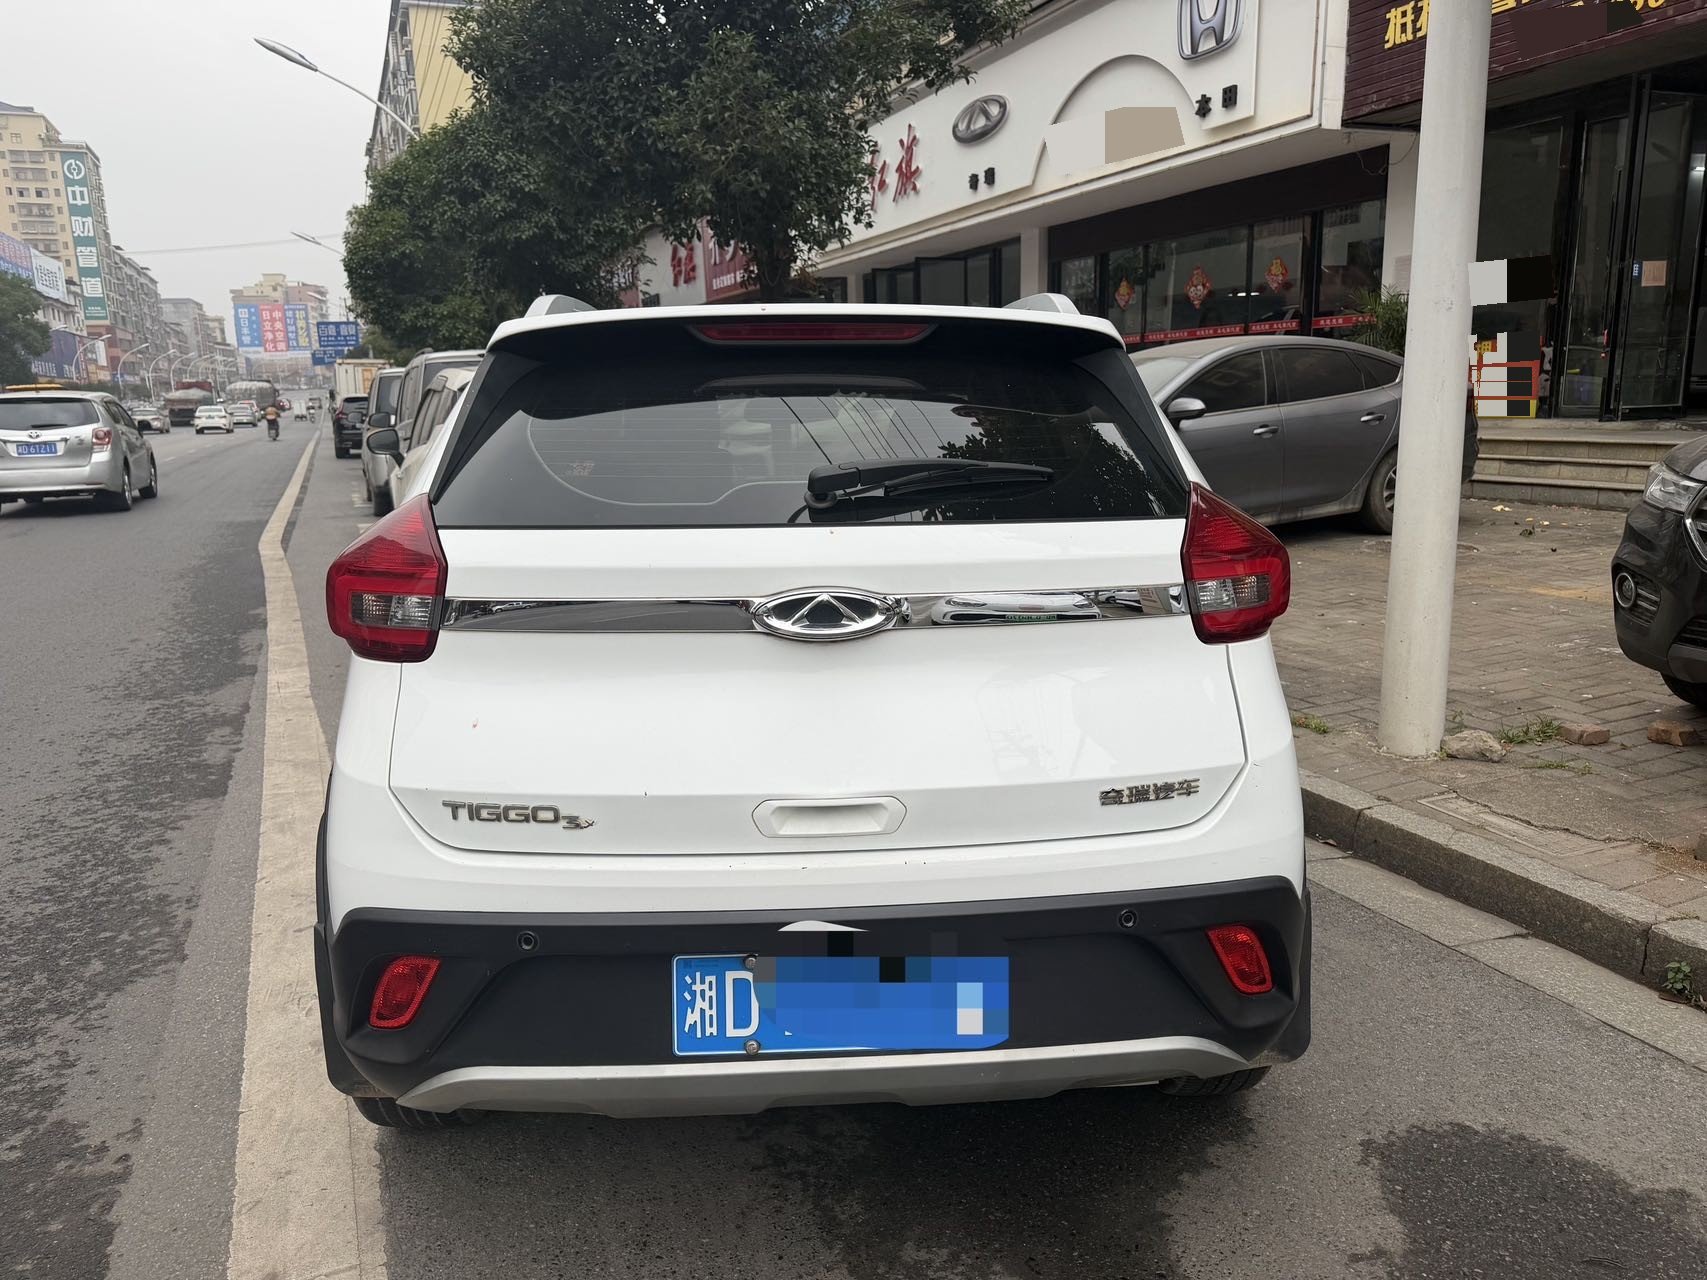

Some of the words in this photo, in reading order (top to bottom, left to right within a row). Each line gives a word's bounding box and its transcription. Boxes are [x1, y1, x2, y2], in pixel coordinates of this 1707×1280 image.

[1195, 85, 1238, 118] 本田
[66, 185, 104, 298] 中财管道
[1099, 779, 1201, 807] 奇瑞汽车
